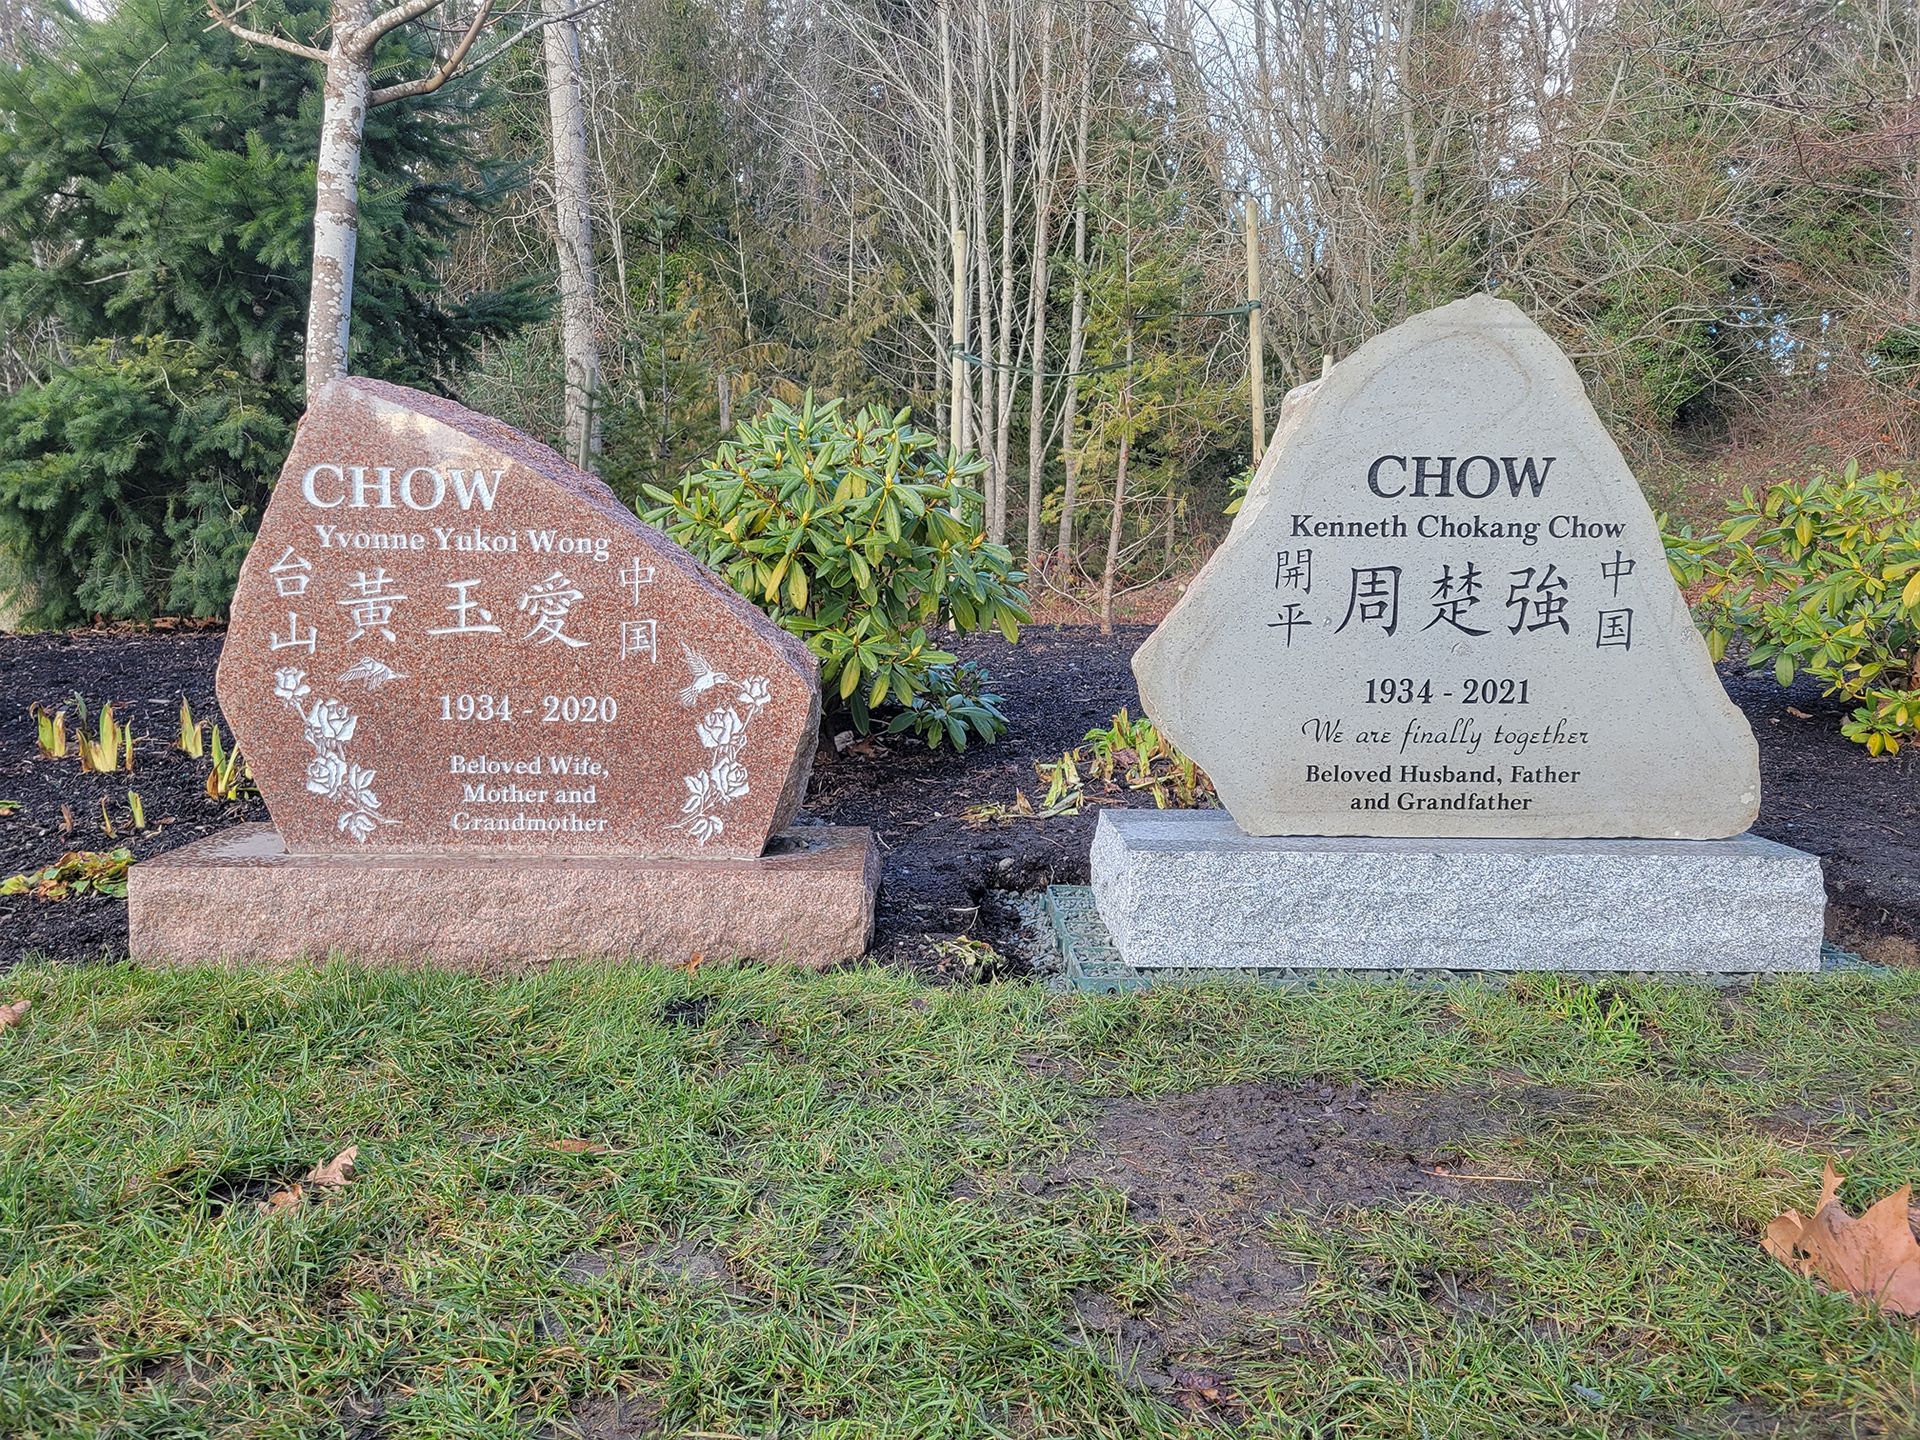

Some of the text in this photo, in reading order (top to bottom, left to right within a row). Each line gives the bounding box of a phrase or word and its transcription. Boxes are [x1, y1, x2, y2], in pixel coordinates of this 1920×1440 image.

[302, 464, 504, 512] CHOW
[1367, 455, 1556, 499] CHOW
[315, 525, 611, 562] Yvonne Yukoi Wong
[1290, 515, 1626, 545] Kenneth Chokang Chow
[1365, 678, 1433, 704] 1934
[1463, 678, 1530, 704] 2021
[438, 695, 512, 722] 1934
[542, 696, 618, 723] 2020
[1301, 717, 1589, 757] We are finally together
[450, 755, 609, 779] Beloved Wife,
[1306, 765, 1581, 787] Beloved Husband, Father
[463, 784, 596, 804] Mother and
[1350, 793, 1532, 811] and Grandfather
[451, 812, 608, 833] Grandmother
